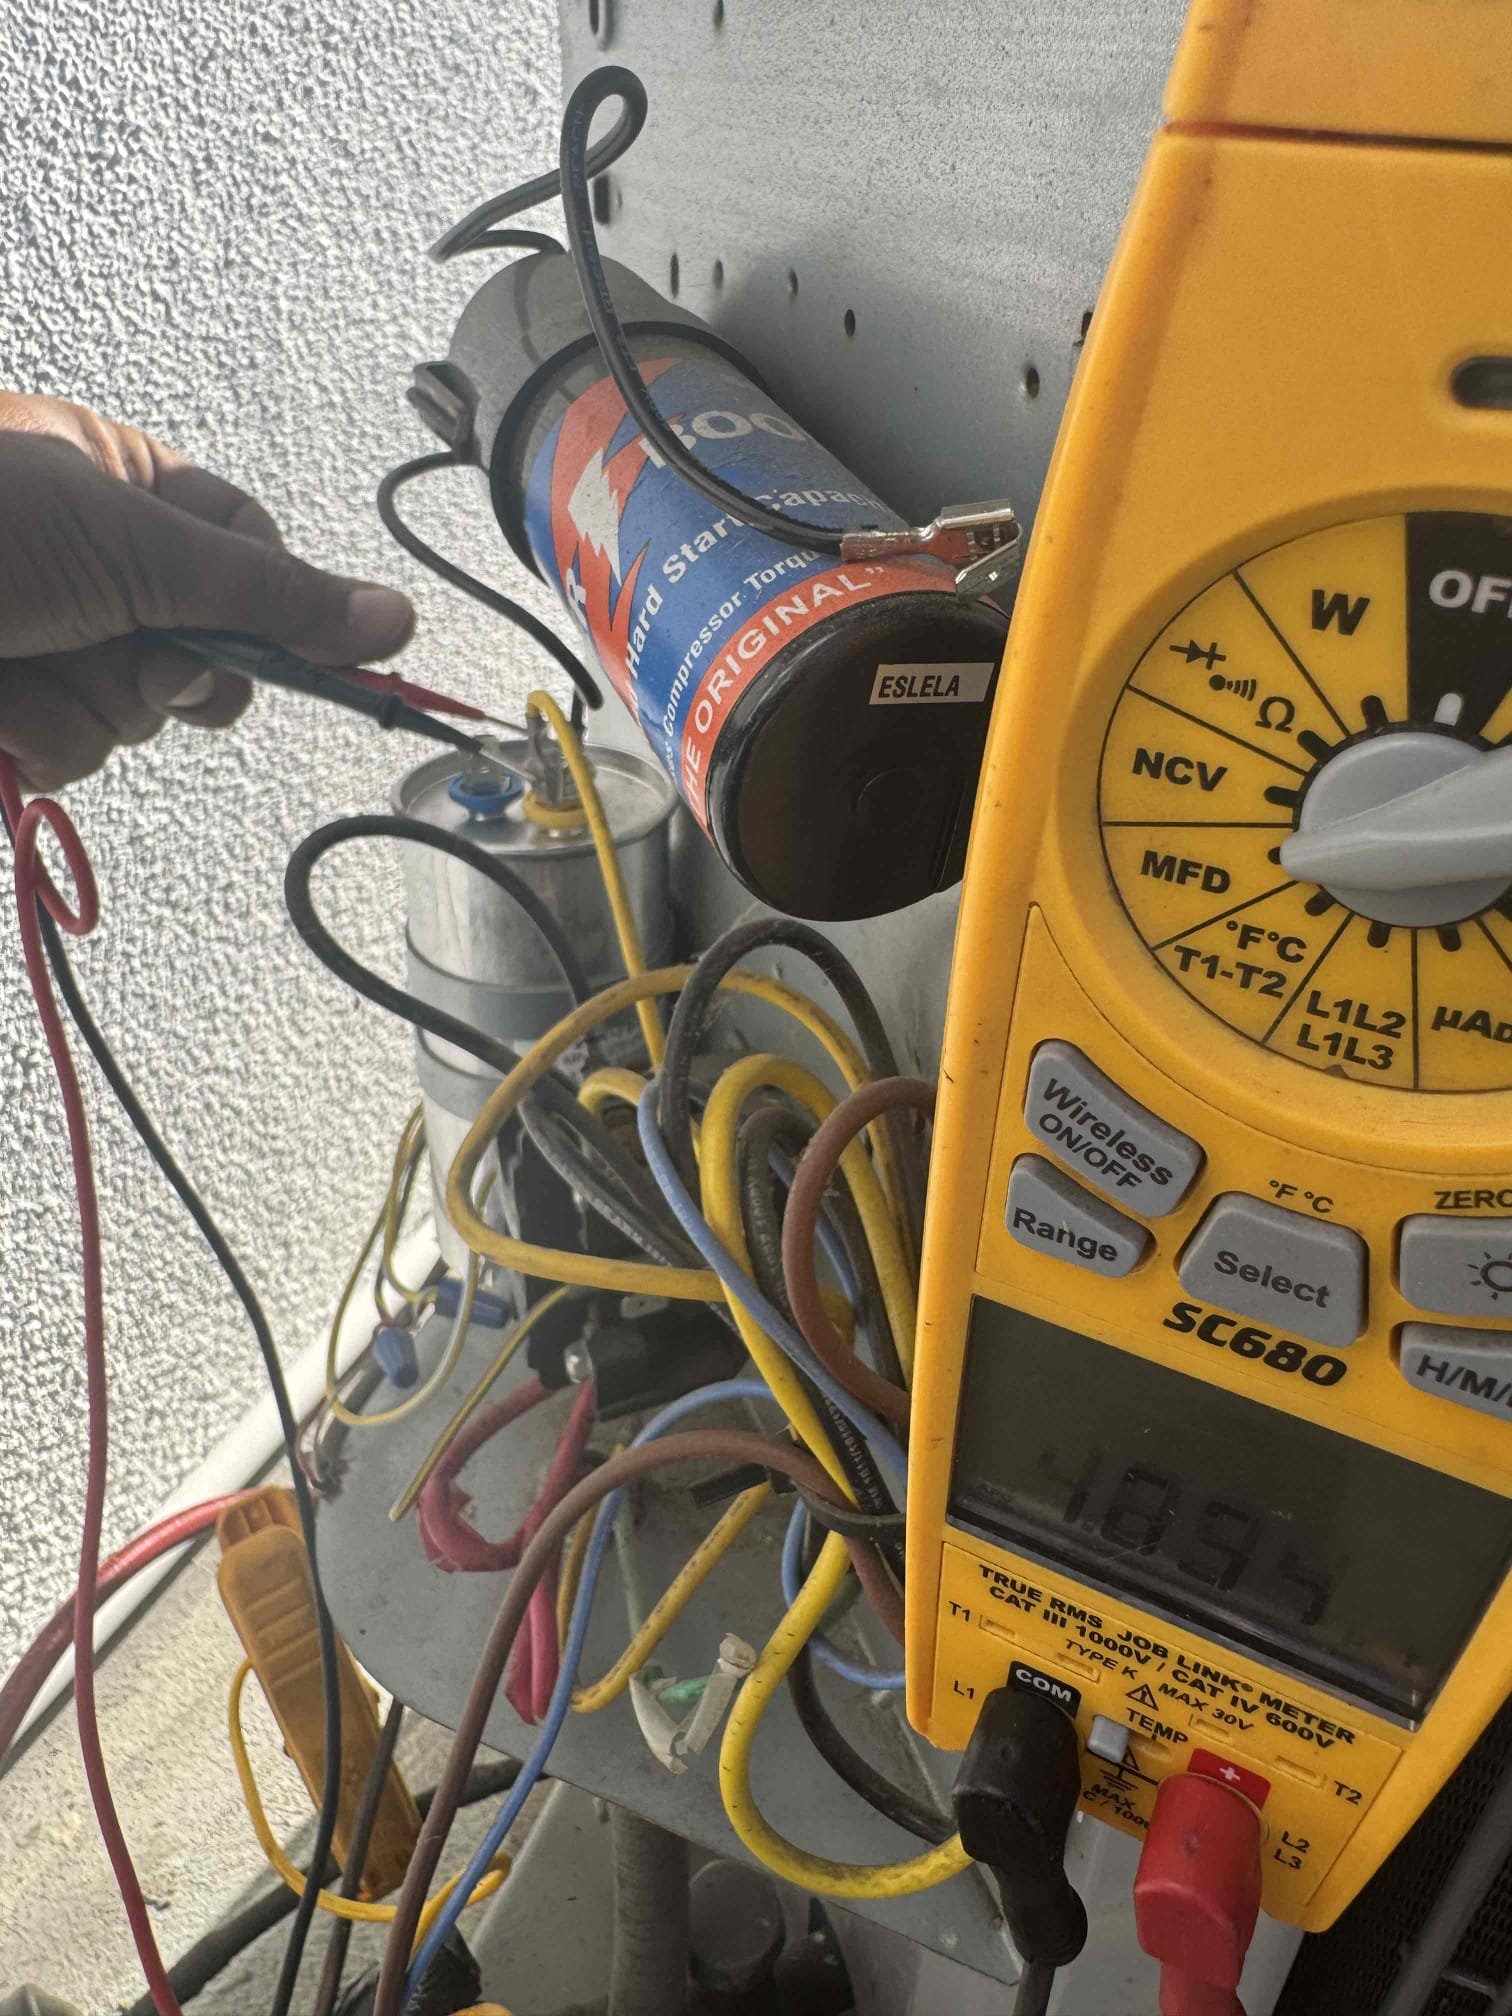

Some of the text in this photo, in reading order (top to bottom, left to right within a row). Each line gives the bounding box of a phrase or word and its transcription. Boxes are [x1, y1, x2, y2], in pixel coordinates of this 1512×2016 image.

[625, 583, 664, 681] Hard
[662, 513, 745, 584] Start
[1311, 589, 1370, 636] W
[663, 550, 822, 738] Compressor Torqu
[878, 675, 960, 698] ESLELA
[1131, 748, 1228, 793] NCV
[1140, 850, 1231, 894] MFD
[1174, 945, 1288, 999] T1-T2
[1306, 990, 1407, 1039] L1L2
[1297, 1024, 1394, 1070] L1L3
[1038, 1113, 1142, 1190] ON/OFF
[1043, 1078, 1173, 1187] Wireless
[1013, 1207, 1118, 1262] Range
[1213, 1251, 1330, 1309] Select
[1163, 1302, 1348, 1387] SC680
[1416, 1354, 1512, 1411] H/M/
[949, 1601, 970, 1622] T1
[979, 1564, 1042, 1603] TRUE
[1049, 1598, 1102, 1629] RMS
[1117, 1630, 1169, 1659] JOB
[1259, 1692, 1356, 1744] METER
[990, 1586, 1036, 1613] CAT
[1043, 1609, 1067, 1628] III
[1076, 1625, 1152, 1665] 1000V
[1172, 1669, 1225, 1698] CAT
[1231, 1695, 1259, 1713] IV
[1266, 1712, 1335, 1749] 600V
[1066, 1639, 1138, 1680] TYPE K
[954, 1680, 975, 1699] L1
[1016, 1668, 1072, 1703] COM
[1158, 1683, 1254, 1730] MAX 30V
[1126, 1707, 1188, 1744] TEMP
[1091, 1784, 1136, 1809] MAX
[1334, 1780, 1362, 1805] T2
[1274, 1849, 1302, 1869] L3
[1282, 1831, 1310, 1854] L2
